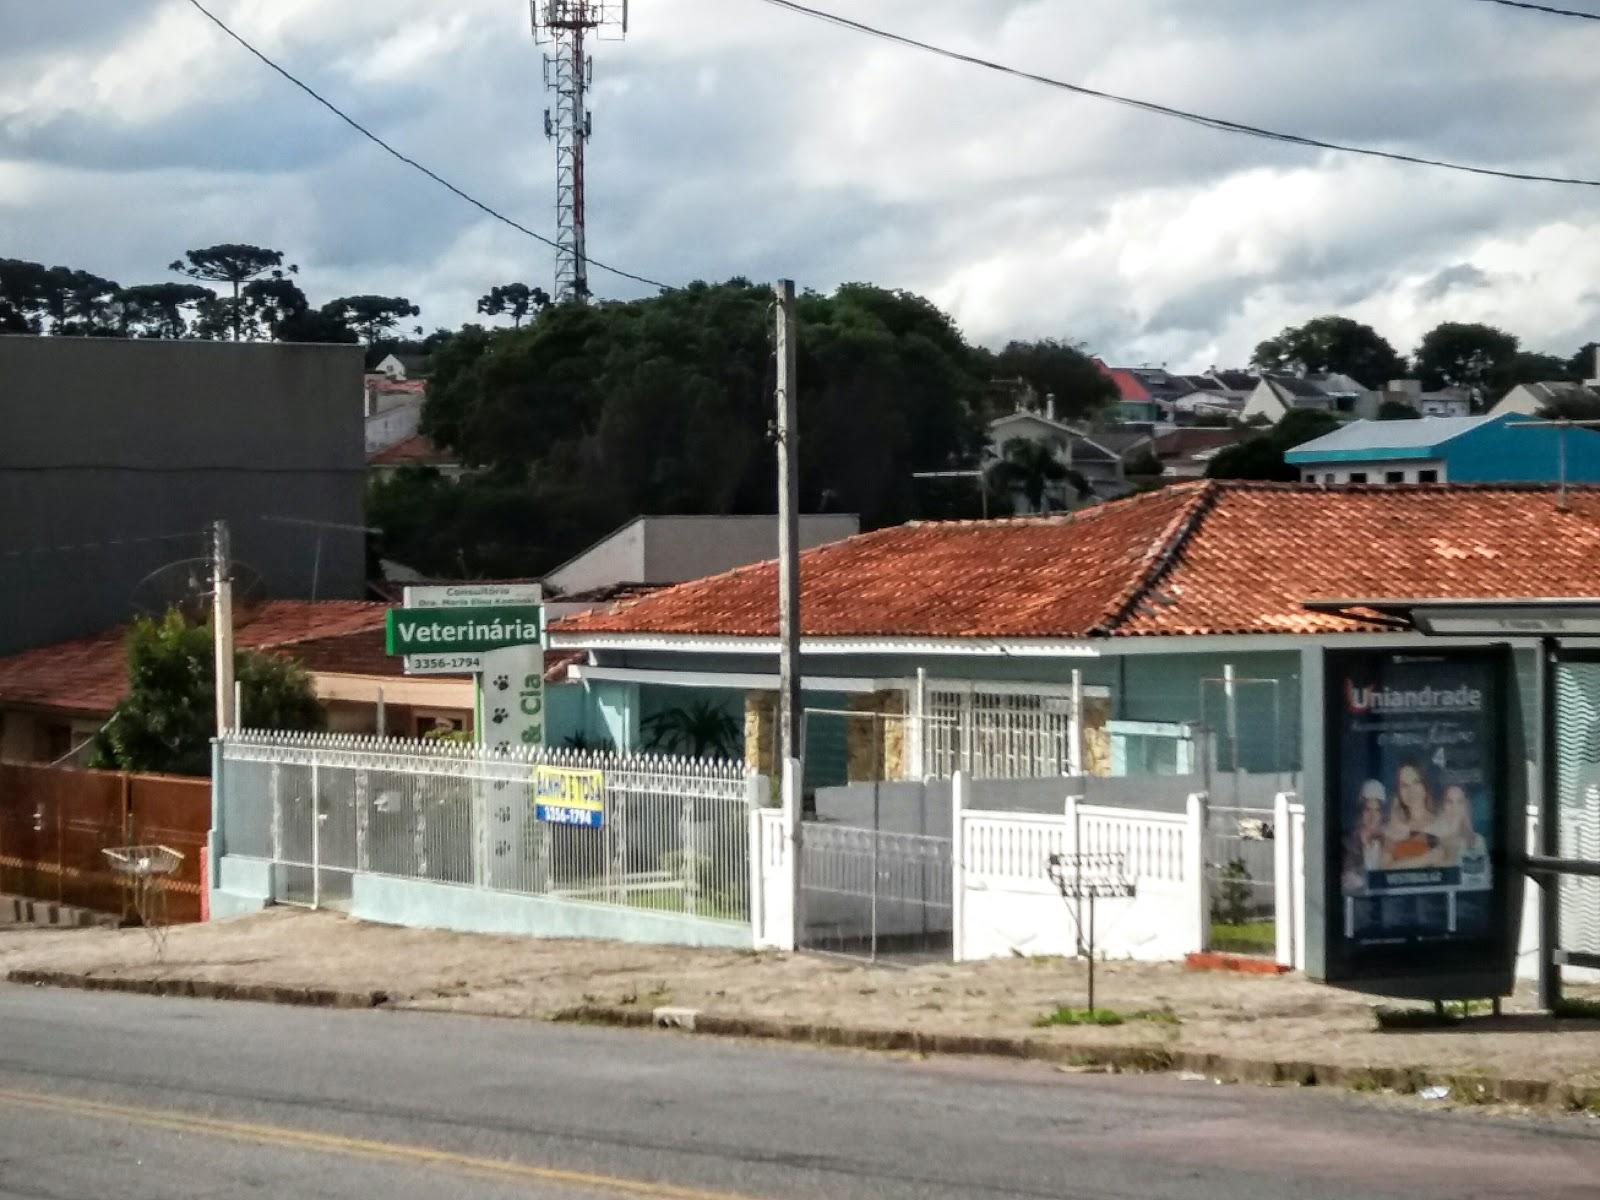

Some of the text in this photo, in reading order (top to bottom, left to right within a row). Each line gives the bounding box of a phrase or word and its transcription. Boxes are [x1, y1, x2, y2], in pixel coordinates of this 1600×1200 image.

[446, 587, 510, 597] Consultório
[398, 617, 537, 642] Veterinária
[414, 657, 480, 669] 3356-1794
[519, 673, 542, 716] Cia
[1346, 681, 1482, 711] Uniandrade
[521, 723, 542, 744] &
